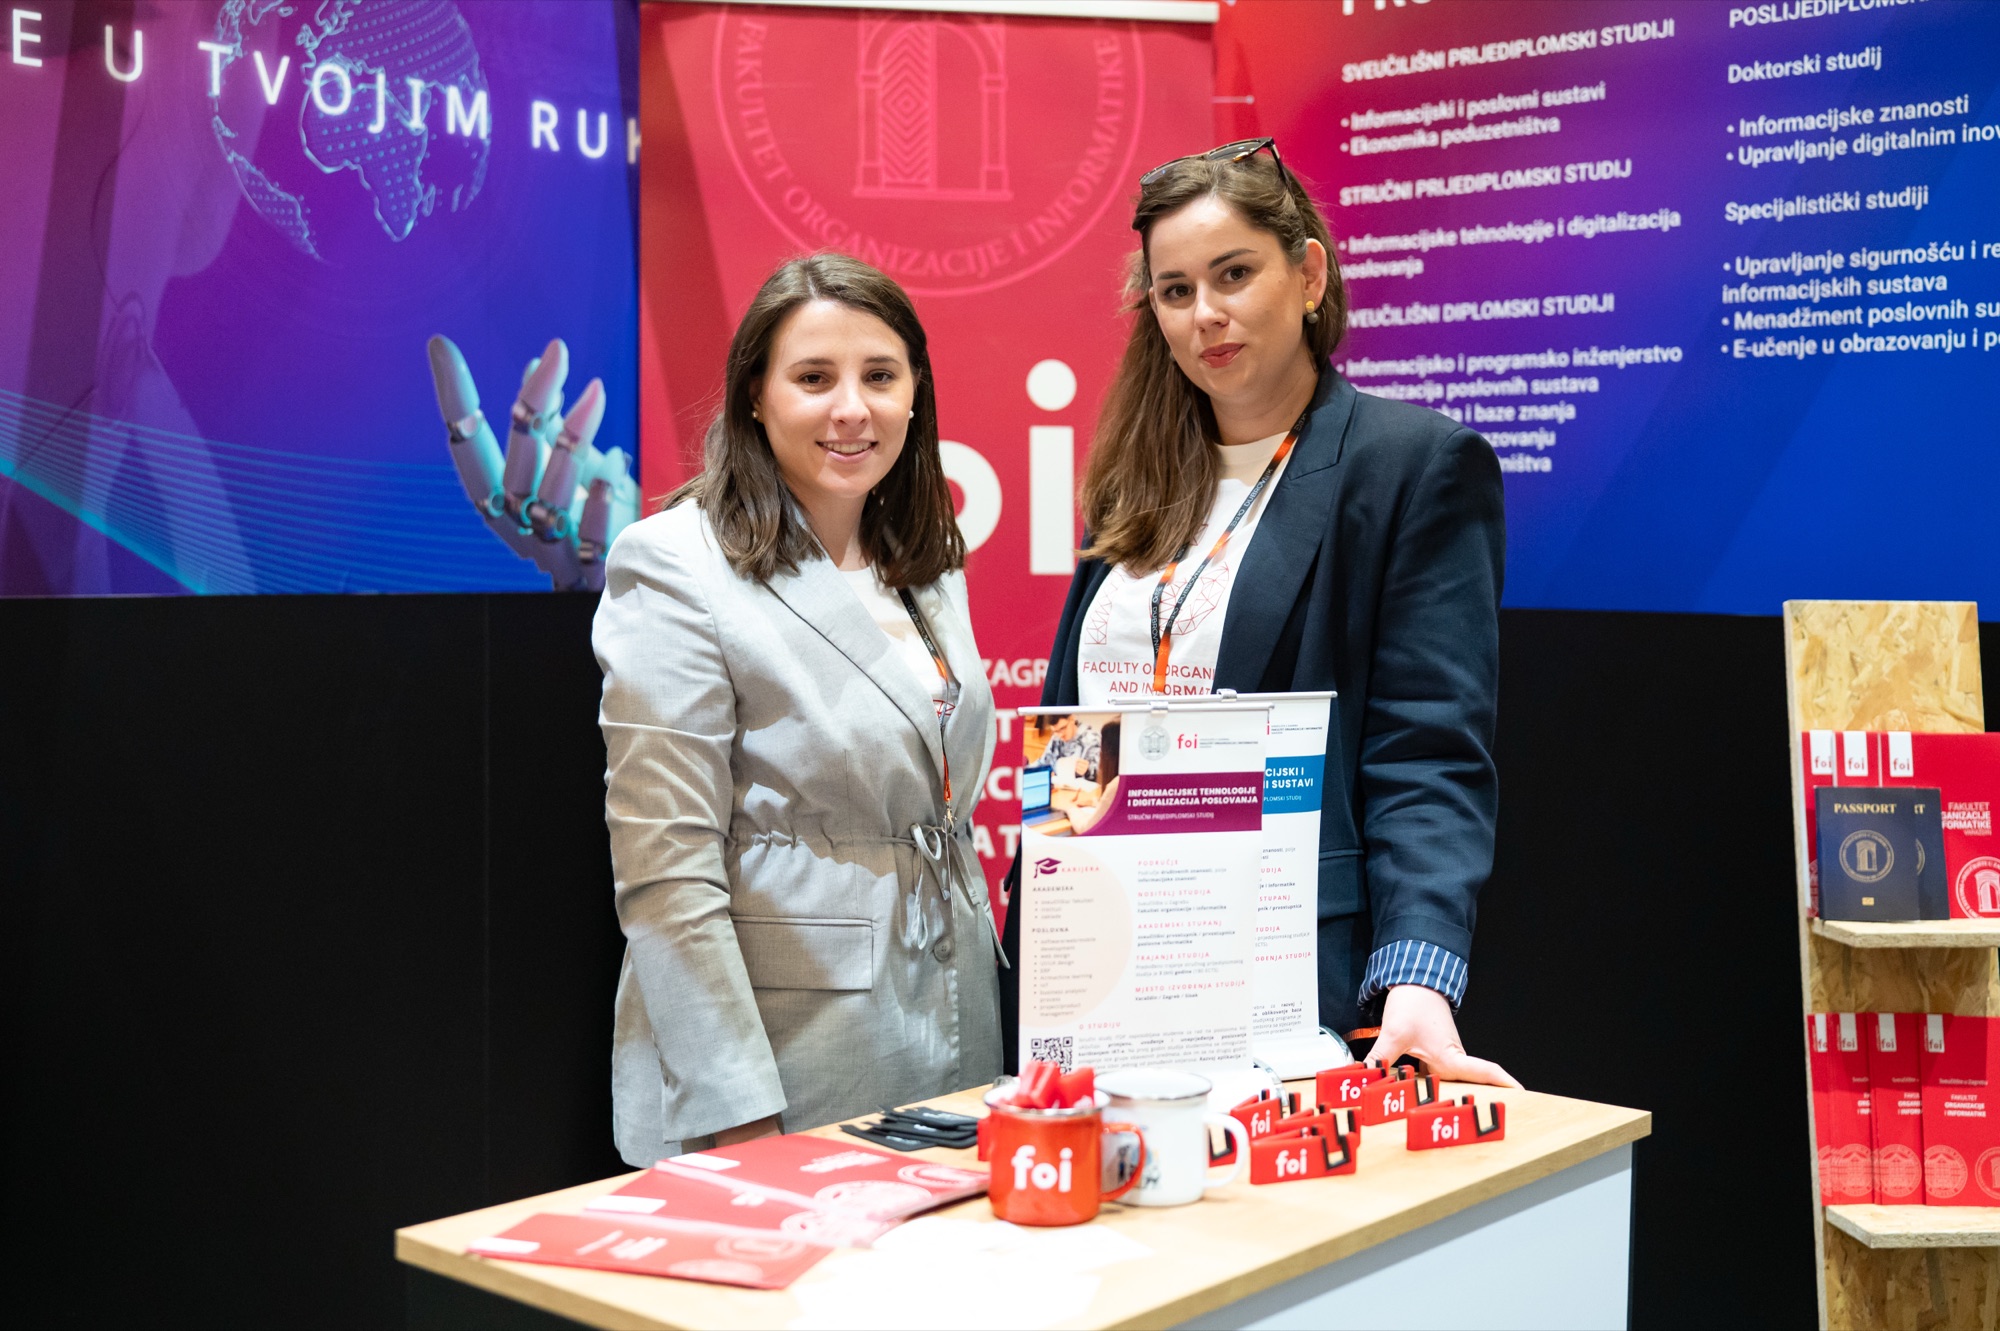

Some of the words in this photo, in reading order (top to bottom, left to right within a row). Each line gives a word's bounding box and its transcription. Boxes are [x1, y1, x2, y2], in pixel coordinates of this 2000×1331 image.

[1342, 50, 1446, 83] SVEUČILIŠNI
[1448, 30, 1597, 68] PRIJEDIPLOMSKI
[1600, 18, 1675, 46] STUDIJI
[1728, 54, 1821, 83] Doktorski
[1826, 45, 1882, 71] studij
[104, 24, 144, 83] U
[198, 41, 490, 140] TVOJIM
[735, 18, 794, 182] FAKULTET
[1350, 100, 1456, 132] Informacijski
[1467, 89, 1540, 121] poslovni
[1542, 80, 1606, 107] sustavi
[1739, 105, 1875, 138] Informacijske
[1879, 94, 1970, 123] znanosti
[1026, 33, 1124, 247] INFORMATIKE
[1350, 129, 1440, 156] Ekonomika
[1441, 114, 1561, 149] poduzetništva
[1738, 136, 1848, 168] Upravljanje
[1852, 127, 1956, 156] digitalnim
[1339, 179, 1413, 206] STRUČNI
[1415, 165, 1562, 199] PRIJEDIPLOMSKI
[1564, 158, 1633, 184] STUDIJ
[1725, 190, 1861, 225] Specijalistički
[1865, 185, 1930, 211] studiji
[1349, 228, 1458, 254] Informacijske
[1460, 218, 1556, 244] tehnologije
[1567, 207, 1682, 239] digitalizacija
[1735, 250, 1845, 280] Upravljanje
[1849, 241, 1965, 271] sigurnošću
[1971, 240, 1977, 260] i
[1722, 275, 1862, 304] informacijskih
[1866, 273, 1948, 297] sustava
[1347, 302, 1441, 329] VEUČILIŠNI
[1443, 296, 1540, 323] DIPLOMSKI
[1543, 292, 1615, 317] STUDIJI
[1733, 305, 1863, 331] Menadžment
[1867, 298, 1969, 328] poslovnih
[1733, 335, 1817, 361] E-učenje
[1822, 338, 1836, 355] u
[1839, 329, 1966, 354] obrazovanju
[1973, 328, 1978, 347] i
[1346, 354, 1456, 378] Informacijsko
[1466, 349, 1570, 376] programsko
[1572, 344, 1683, 369] inženjerstvo
[1446, 376, 1528, 403] poslovnih
[1530, 375, 1599, 395] sustava
[1474, 402, 1516, 422] baze
[1517, 400, 1576, 424] znanja
[1083, 661, 1139, 674] FACULTY
[1109, 681, 1138, 693] AND
[1177, 733, 1198, 749] foi
[1814, 756, 1832, 768] foi
[1848, 758, 1865, 770] foi
[1893, 758, 1910, 770] foi
[1128, 787, 1197, 797] INFORMACIJSKE
[1199, 786, 1256, 796] TEHNOLOGIJE
[1271, 777, 1314, 789] SUSTAVI
[1132, 798, 1200, 807] DIGITALIZACIJA
[1202, 795, 1258, 805] POSLOVANJA
[1833, 803, 1897, 814] PASSPORT
[1948, 802, 1990, 811] FAKULTET
[1061, 866, 1100, 874] KARIJERA
[1179, 888, 1211, 896] STUDIJA
[1285, 951, 1311, 959] STUDIJA
[1135, 985, 1165, 993] MJESTO
[1216, 979, 1246, 988] STUDIJA
[1383, 1089, 1405, 1117] foi
[1251, 1109, 1271, 1138] foi
[1431, 1116, 1459, 1143] foi
[1011, 1144, 1073, 1193] foi
[1275, 1149, 1307, 1178] foi
